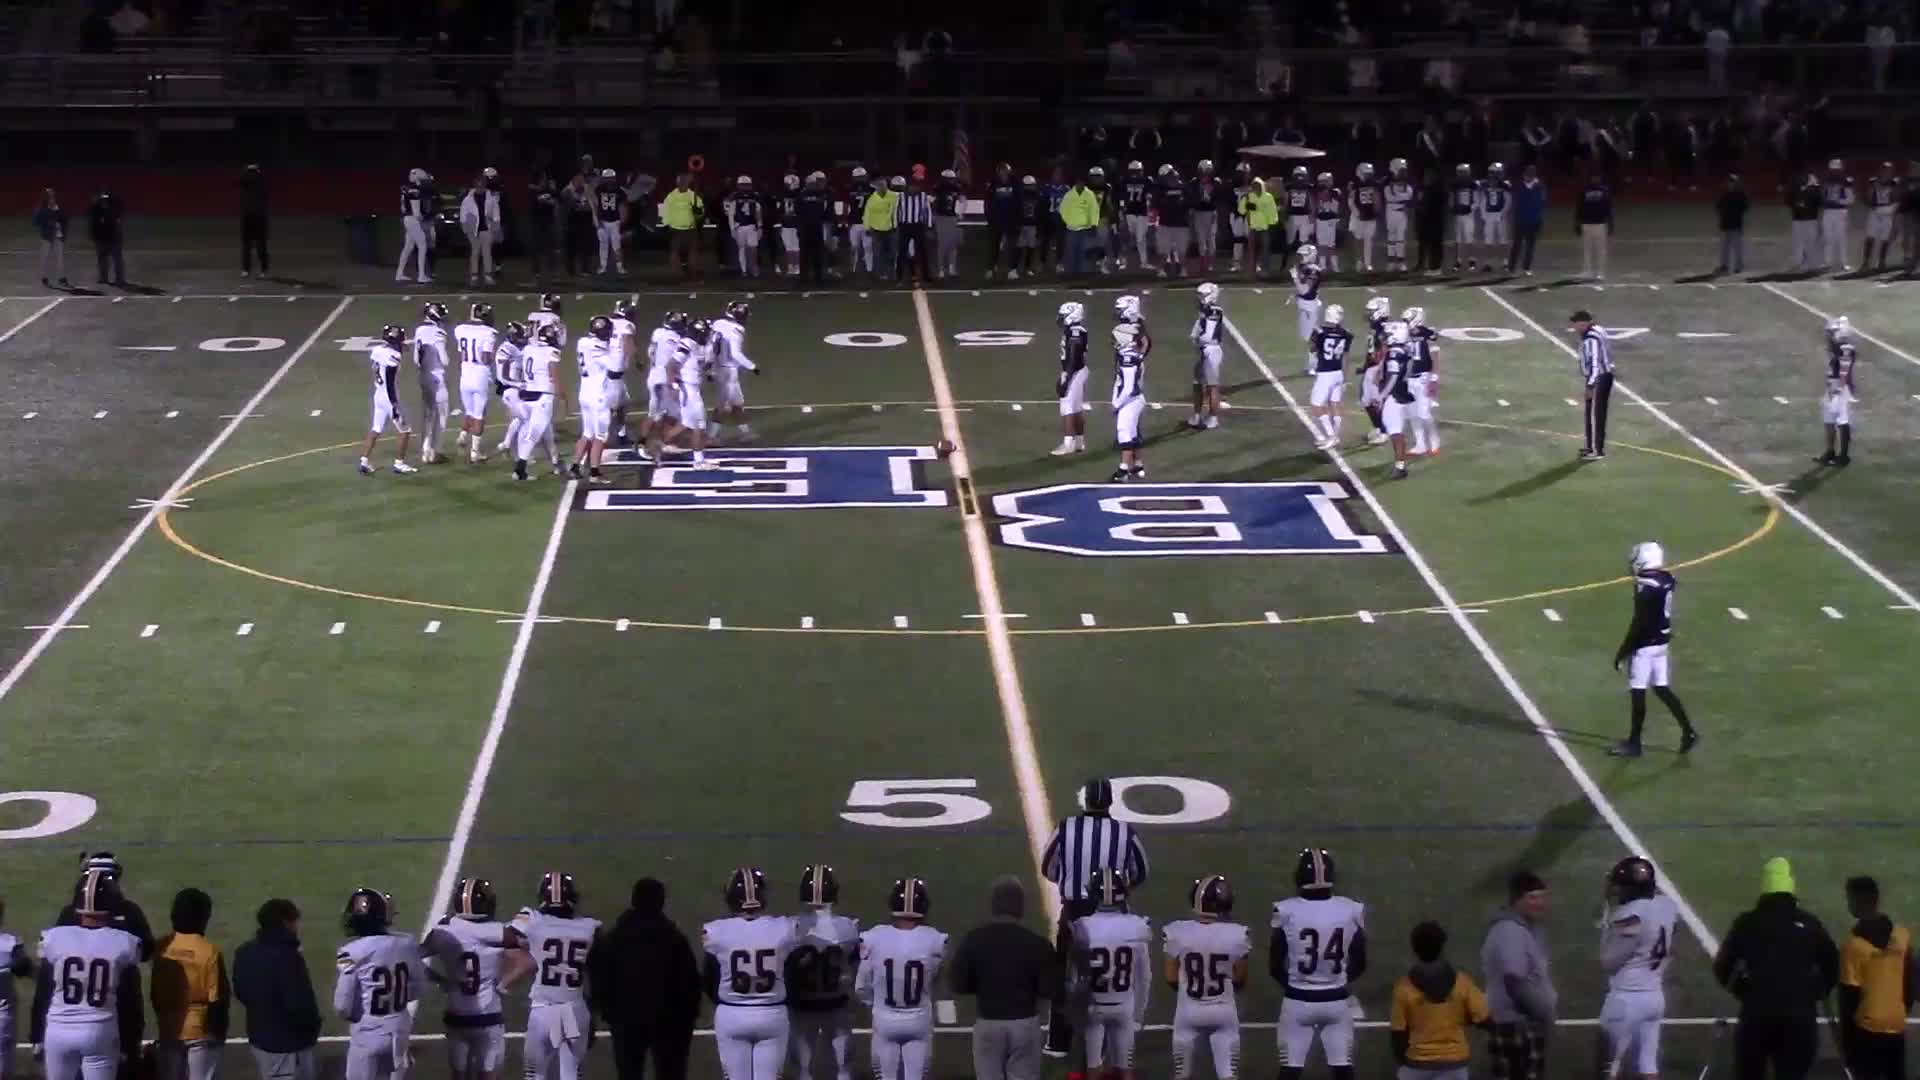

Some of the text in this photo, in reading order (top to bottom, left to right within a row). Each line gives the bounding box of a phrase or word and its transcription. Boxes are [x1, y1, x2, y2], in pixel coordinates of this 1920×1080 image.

[1323, 338, 1346, 361] 54
[541, 938, 588, 988] 25
[1088, 945, 1134, 993] 28
[1298, 927, 1345, 975] 34
[1649, 924, 1667, 970] 4
[63, 956, 110, 1008] 60
[369, 960, 410, 1016] 20
[729, 949, 777, 994] 65
[882, 958, 925, 1007] 10
[1184, 951, 1230, 999] 85
